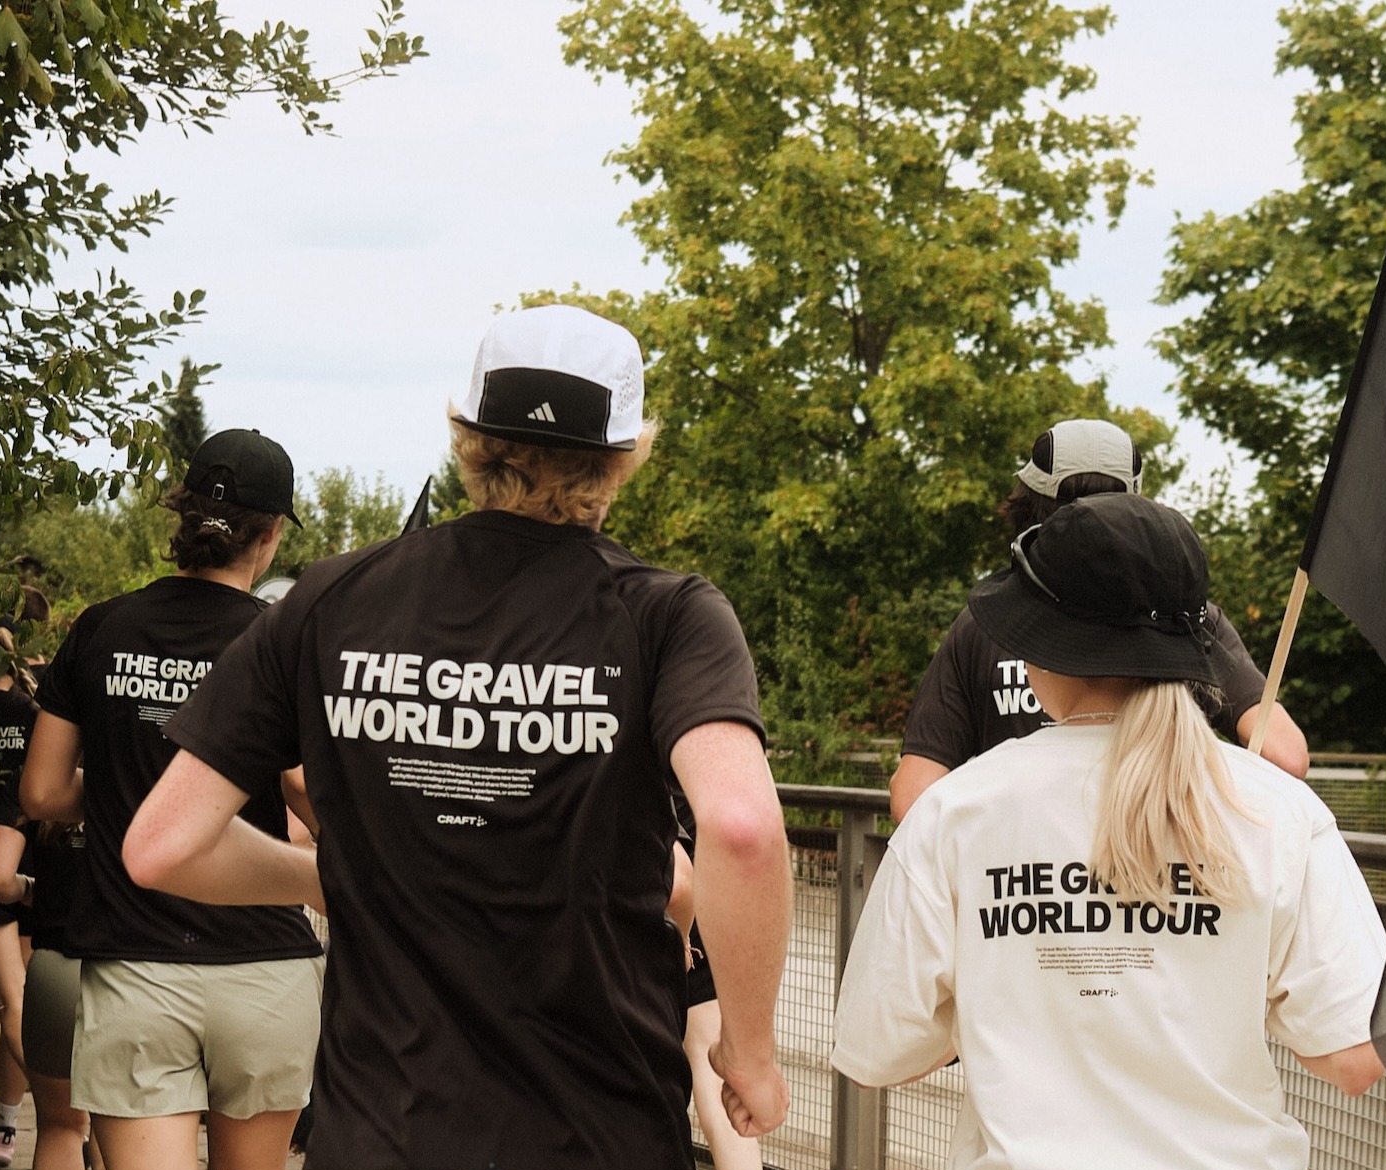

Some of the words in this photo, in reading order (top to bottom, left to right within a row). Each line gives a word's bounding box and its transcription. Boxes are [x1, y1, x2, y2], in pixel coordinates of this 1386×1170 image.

[113, 653, 158, 677] THE
[339, 651, 423, 696] THE
[425, 659, 608, 706] GRAVEL
[106, 675, 189, 703] WORLD
[324, 695, 485, 750] WORLD
[490, 710, 620, 755] TOUR
[437, 815, 477, 825] CRAFT
[986, 862, 1054, 899] THE
[979, 901, 1111, 939] WORLD
[1116, 901, 1221, 936] TOUR
[1080, 989, 1110, 997] CRAFT
